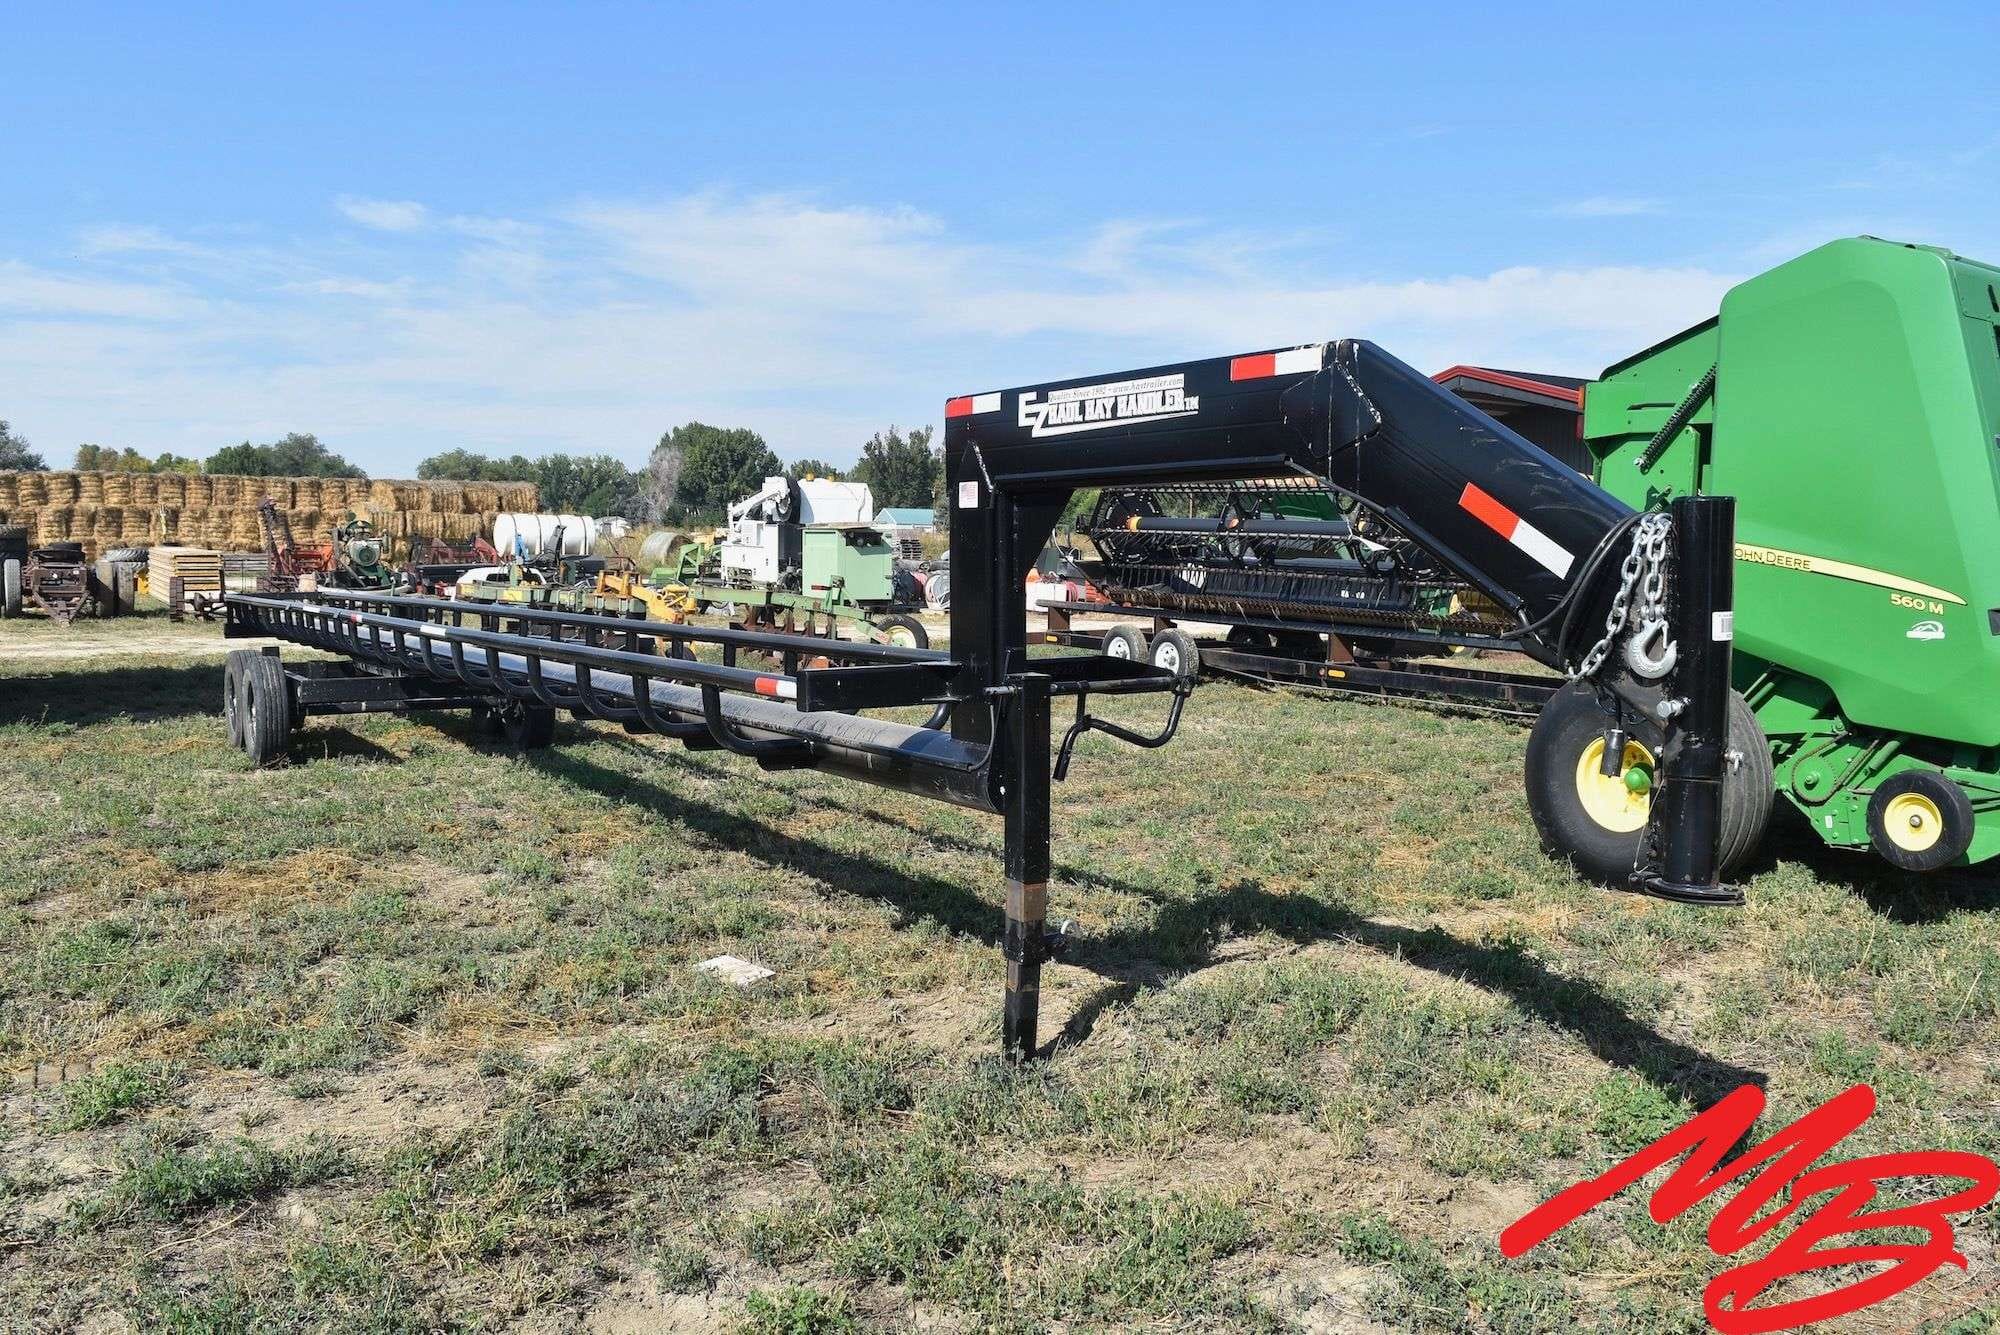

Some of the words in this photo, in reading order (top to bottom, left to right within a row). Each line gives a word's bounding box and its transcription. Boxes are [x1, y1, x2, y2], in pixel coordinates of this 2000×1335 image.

[1048, 401, 1083, 425] HAUL
[1084, 397, 1116, 420] HAY
[1116, 388, 1184, 417] HANDLER
[1734, 548, 1763, 561] OHN
[1766, 551, 1811, 570] DEERE
[1890, 593, 1926, 611] 560
[1928, 601, 1945, 615] M
